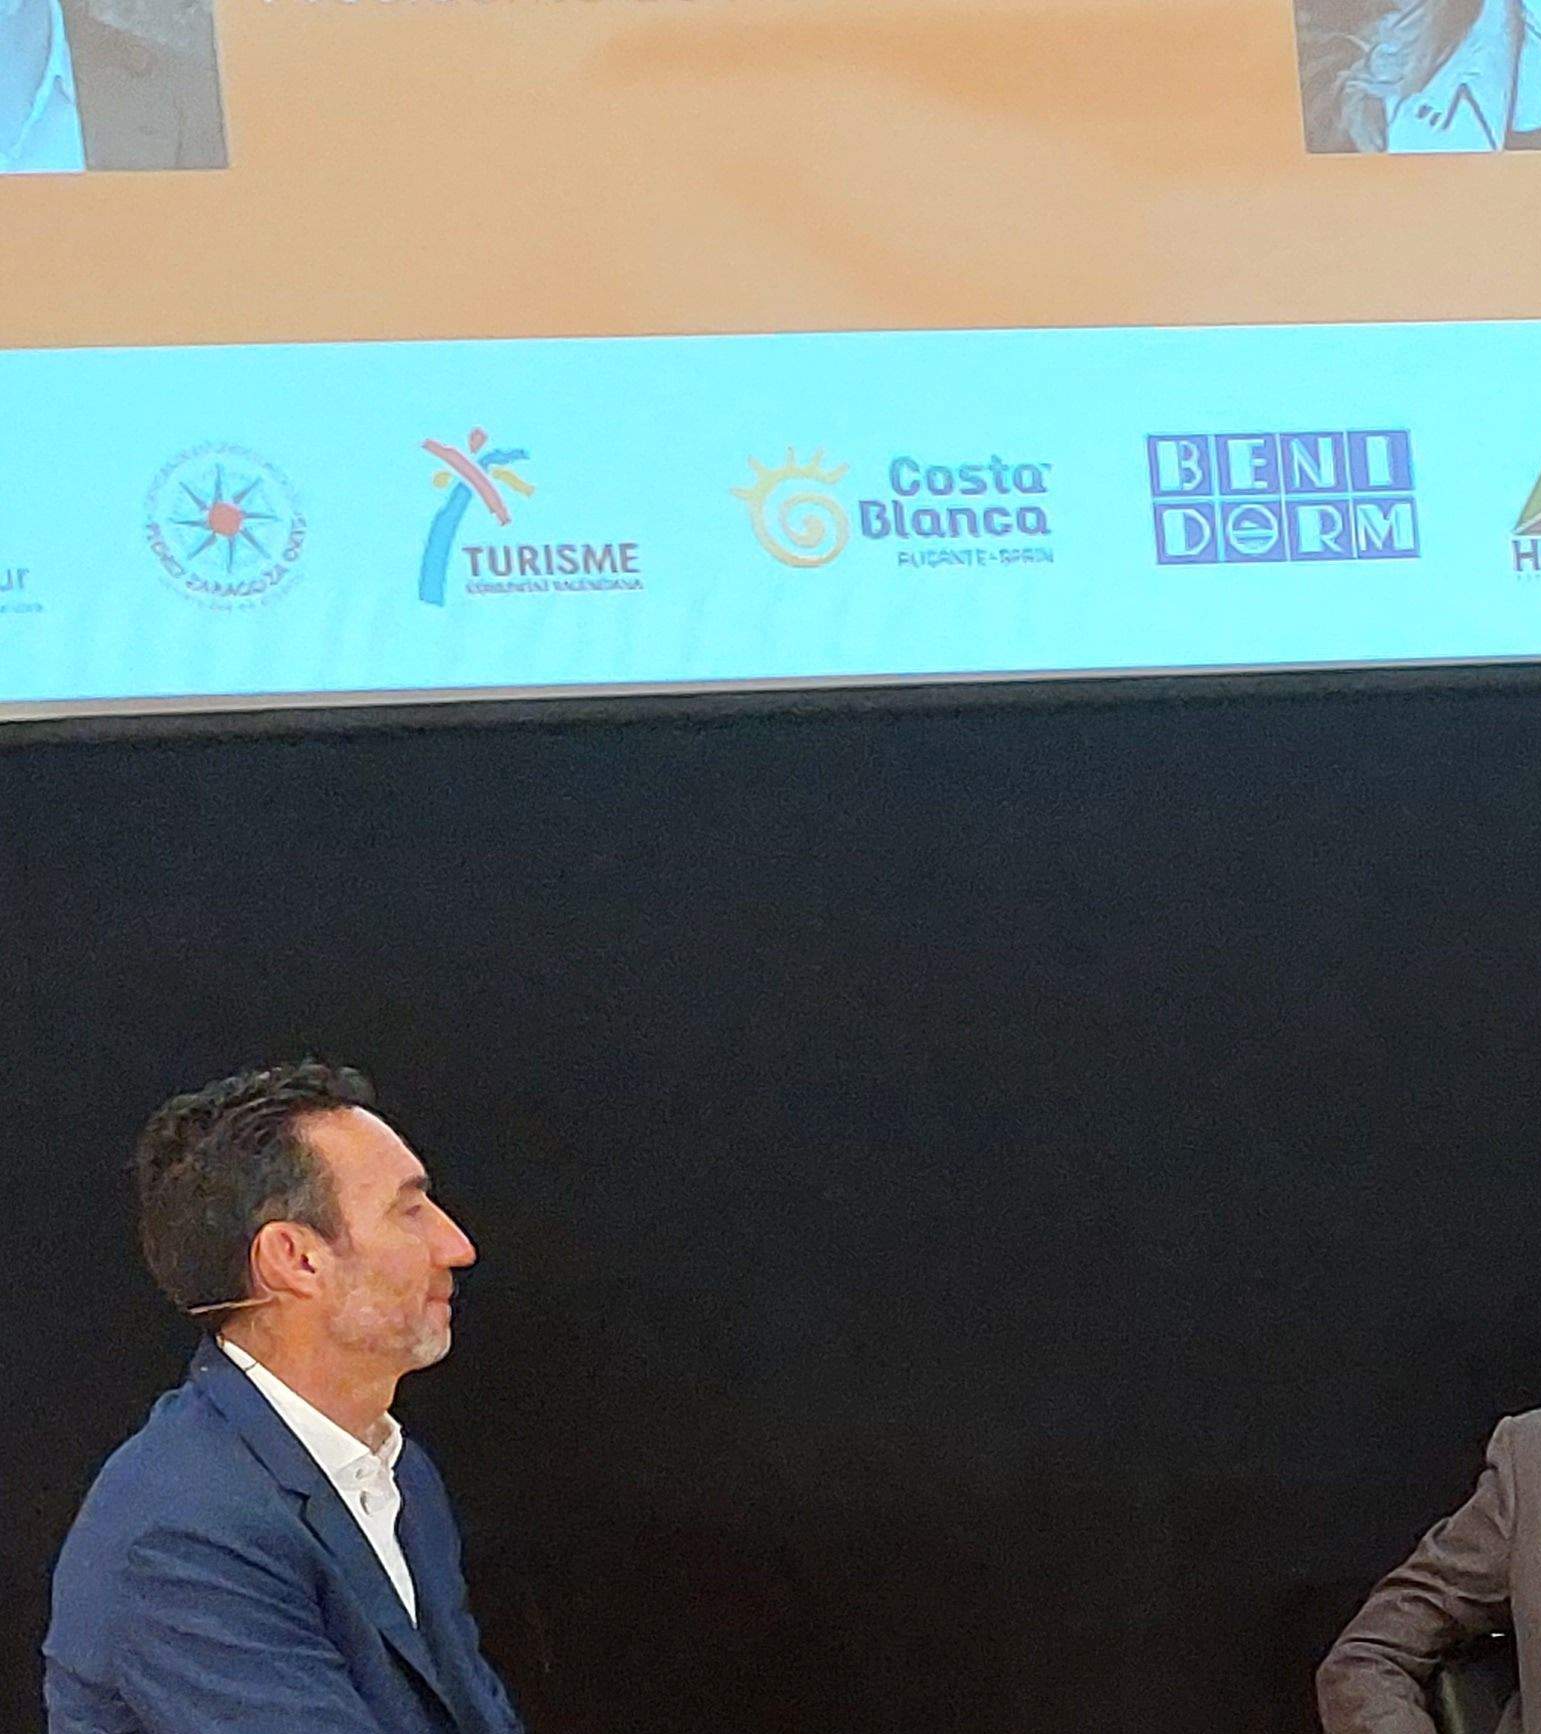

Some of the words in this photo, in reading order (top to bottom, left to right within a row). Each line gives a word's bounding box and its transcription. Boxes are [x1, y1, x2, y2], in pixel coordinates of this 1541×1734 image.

[889, 454, 1049, 497] Costa
[858, 499, 1052, 540] Blanca
[462, 542, 641, 577] TURISME
